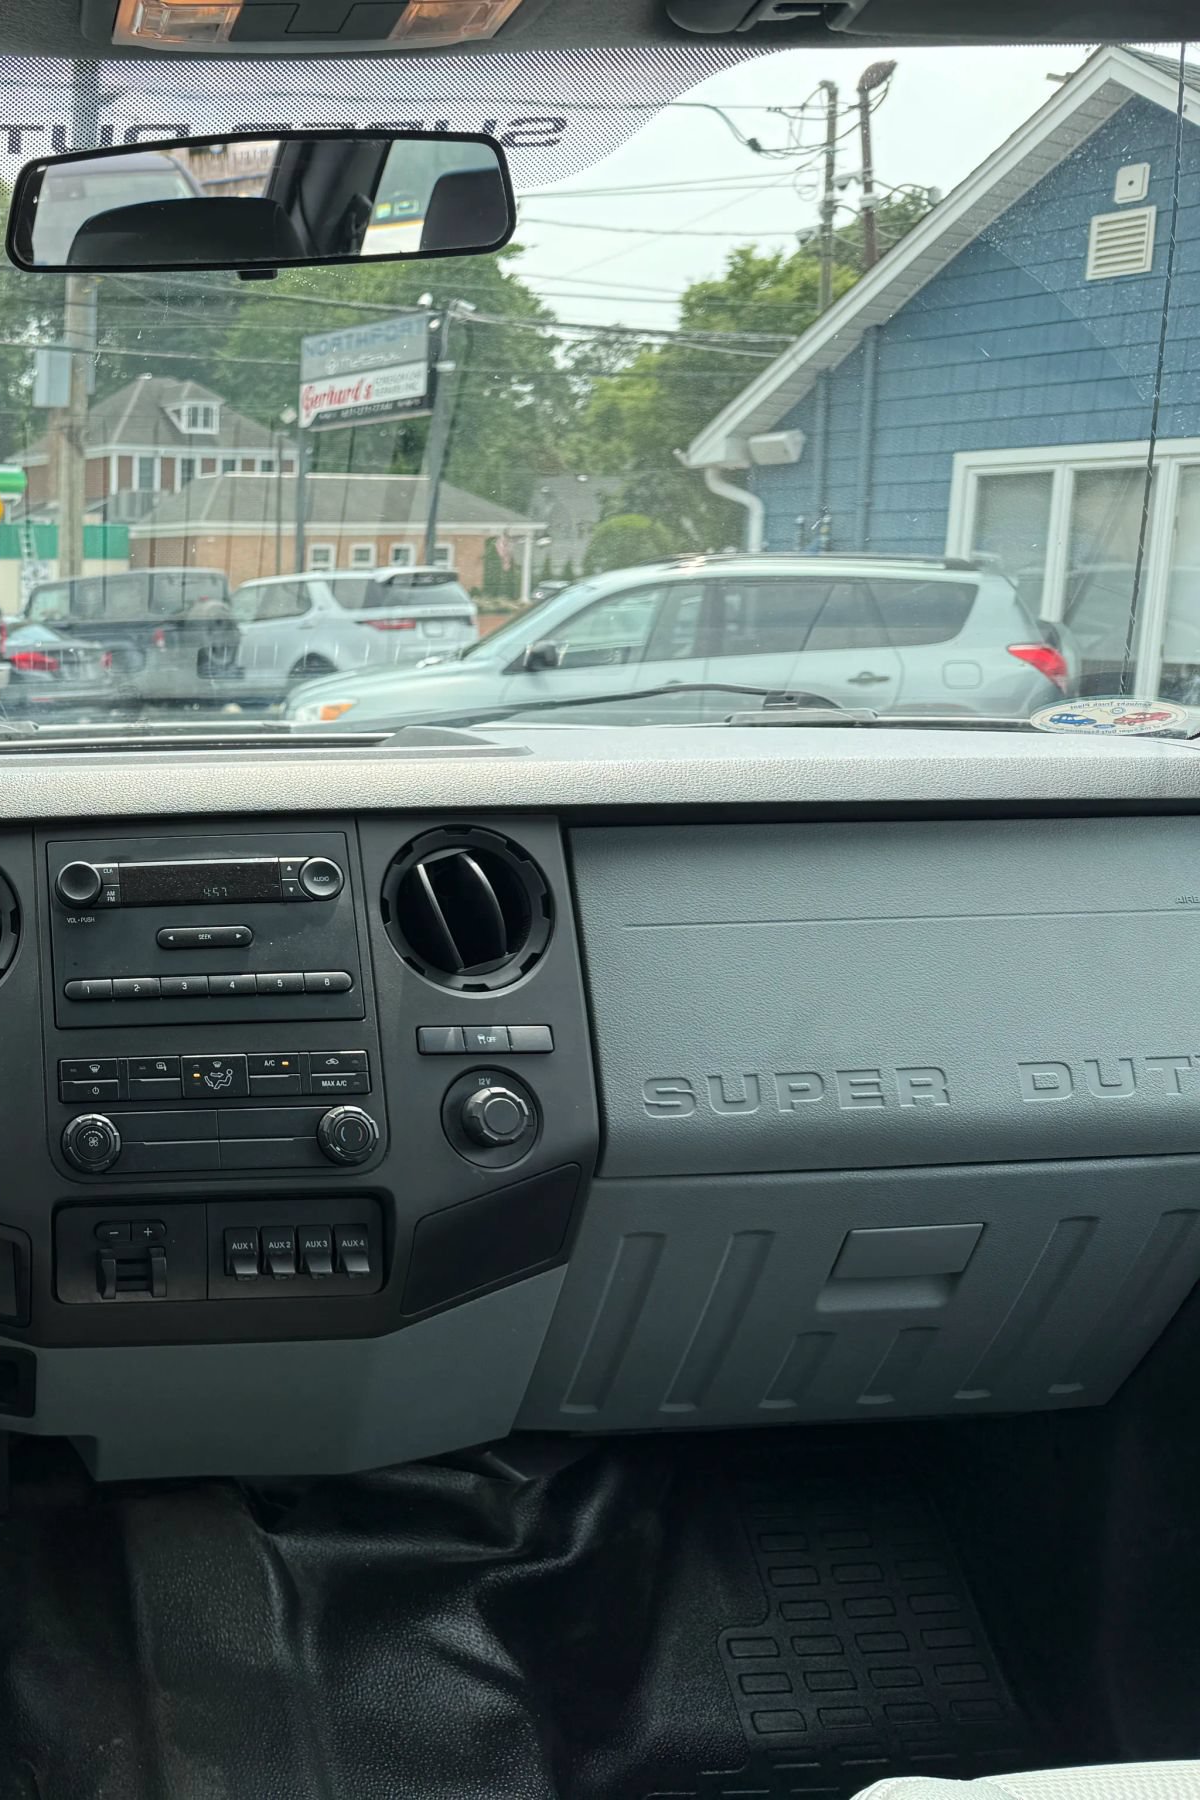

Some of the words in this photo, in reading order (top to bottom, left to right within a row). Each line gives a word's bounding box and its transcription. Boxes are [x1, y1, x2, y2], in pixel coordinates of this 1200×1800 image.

[264, 1059, 276, 1067] A/C
[321, 1079, 334, 1088] MAX
[335, 1079, 348, 1087] A/C
[641, 1065, 952, 1119] SUPER
[1016, 1054, 1200, 1102] DUT
[231, 1241, 249, 1250] AUX
[268, 1240, 285, 1249] AUX
[305, 1239, 321, 1248] AUX
[341, 1238, 358, 1247] AUX
